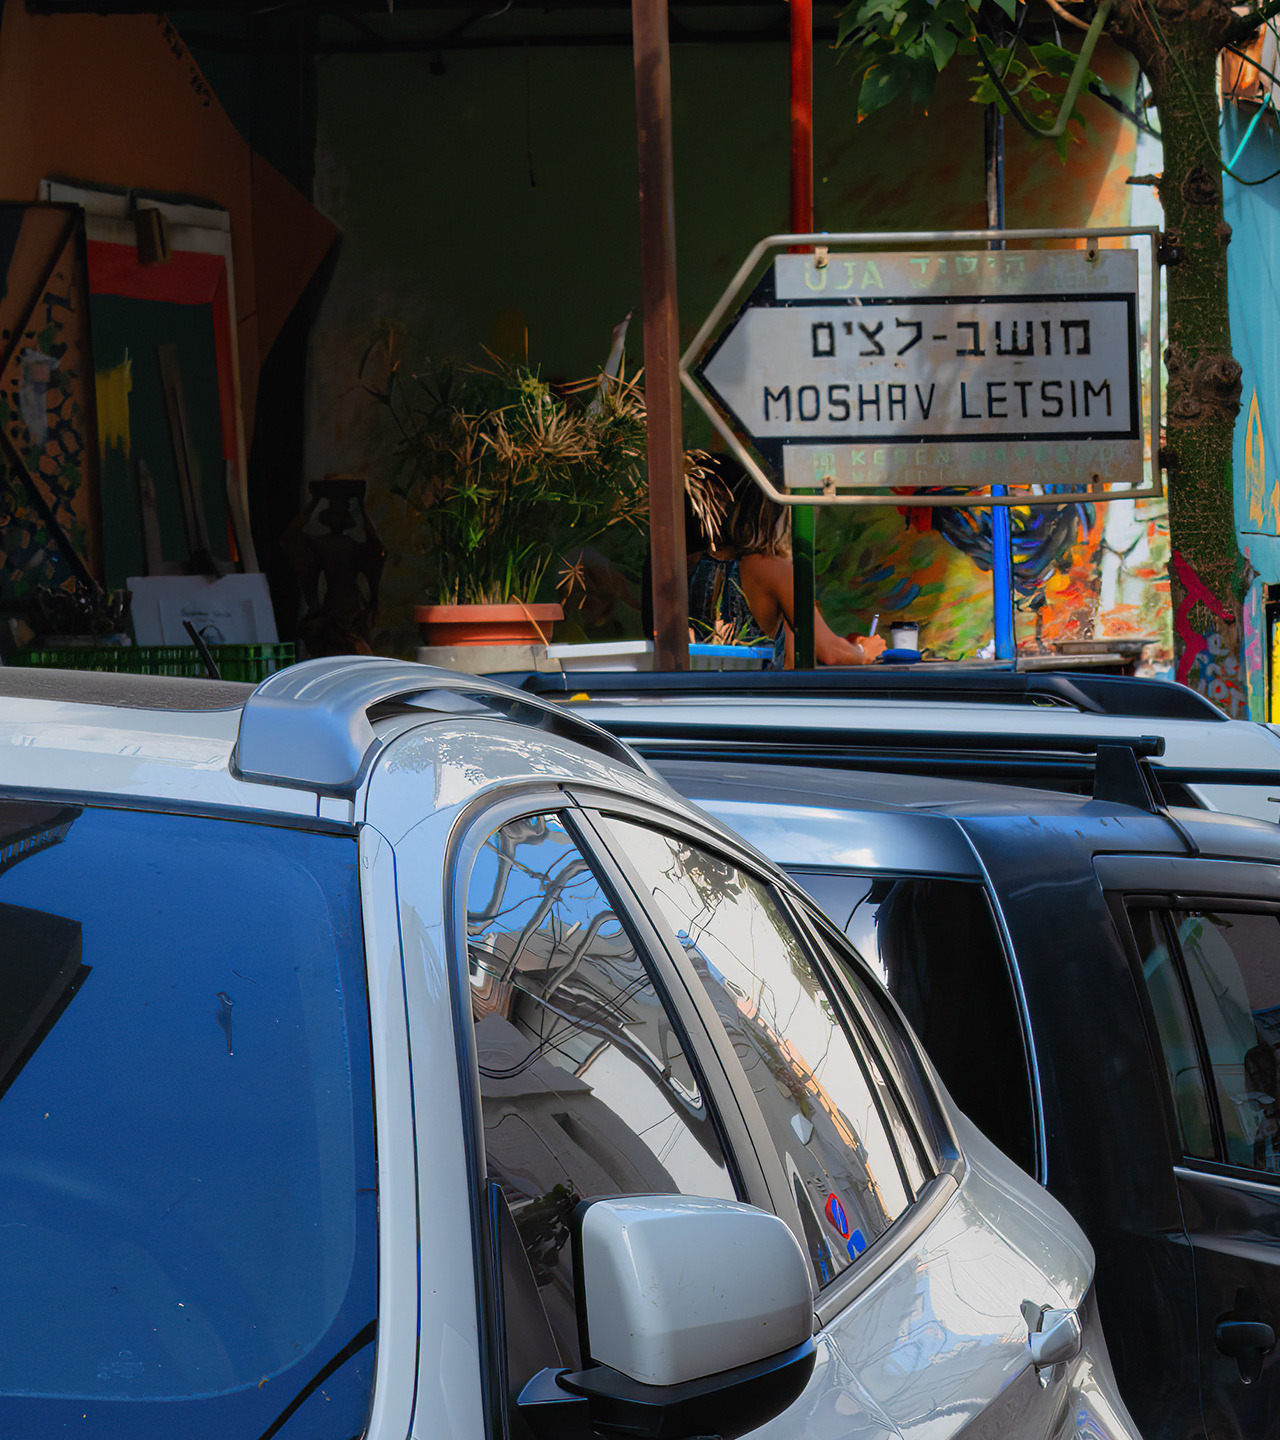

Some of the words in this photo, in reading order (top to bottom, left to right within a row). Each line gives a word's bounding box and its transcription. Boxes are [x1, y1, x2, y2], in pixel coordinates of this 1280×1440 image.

[803, 259, 885, 292] UJA
[763, 382, 936, 422] MOSHAV
[960, 380, 1112, 419] LETSIM
